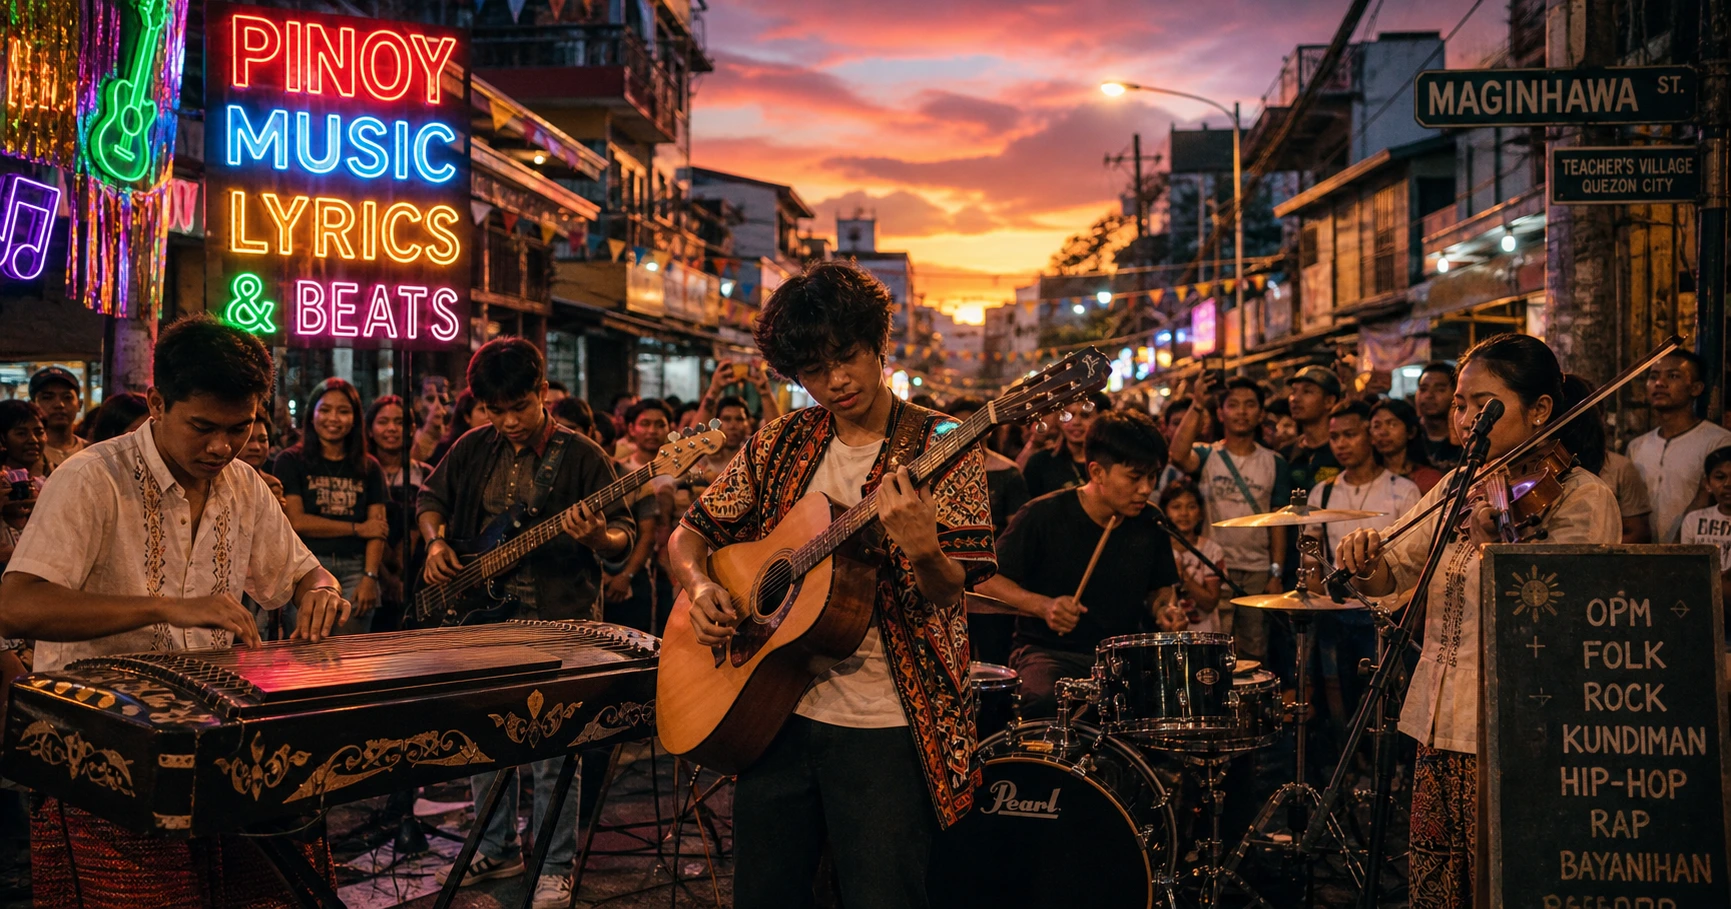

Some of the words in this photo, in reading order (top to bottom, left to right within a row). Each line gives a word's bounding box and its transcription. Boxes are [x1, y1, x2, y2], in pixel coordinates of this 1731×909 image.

[231, 14, 457, 105] PINOY
[1428, 78, 1639, 116] MAGINHAWA
[1657, 75, 1685, 95] ST.
[226, 104, 456, 183] MUSIC
[1562, 158, 1635, 176] TEACHER'S
[1639, 156, 1694, 175] VILLAGE
[1581, 179, 1637, 194] QUEZON
[1642, 178, 1674, 193] CITY
[230, 190, 461, 266] LYRICS
[226, 273, 276, 334] &
[295, 279, 461, 342] BEATS
[1586, 597, 1652, 628] OPM
[1582, 640, 1668, 670] FOLK
[1583, 681, 1668, 713] ROCK
[1562, 723, 1707, 756] KUNDIMAN
[980, 780, 1061, 813] Pearl
[1560, 766, 1688, 800] HIP-HOP
[1590, 808, 1651, 839] RAP
[1560, 850, 1713, 884] BAYANIHAN
